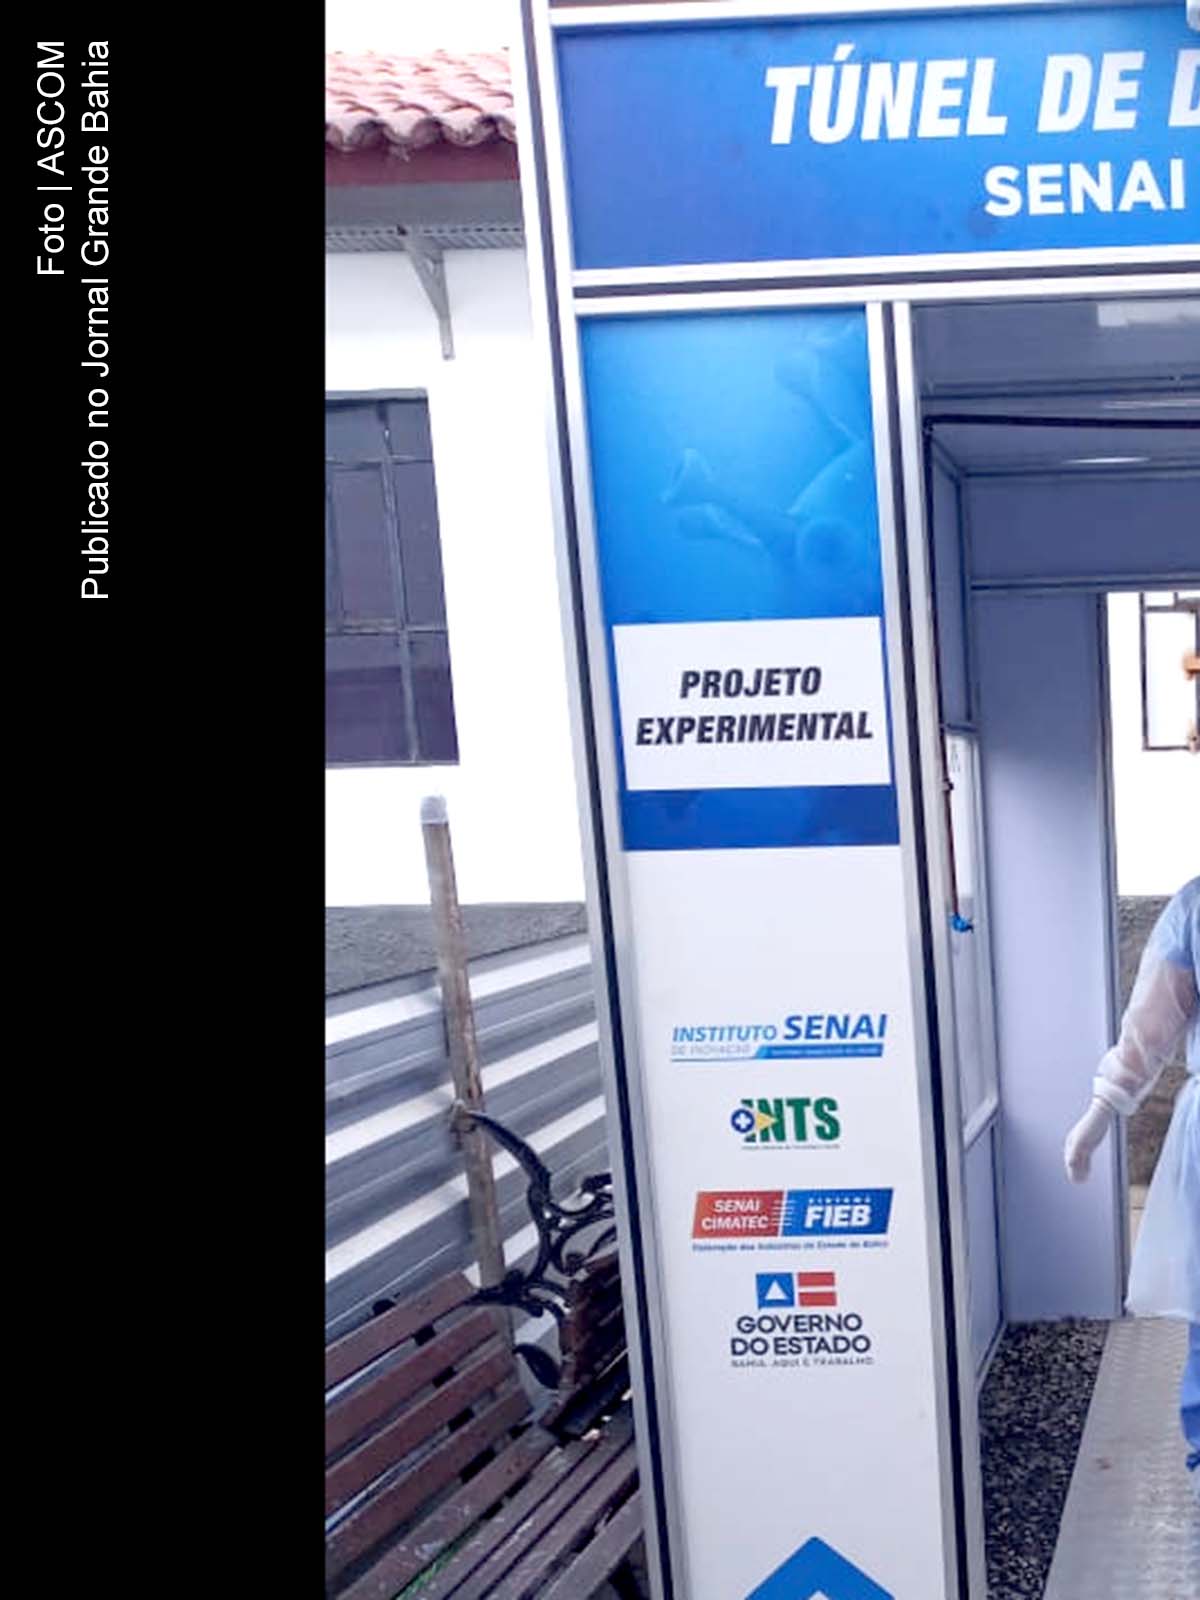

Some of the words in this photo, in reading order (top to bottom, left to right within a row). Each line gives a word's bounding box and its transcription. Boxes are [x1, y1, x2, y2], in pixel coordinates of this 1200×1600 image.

[765, 43, 1008, 145] TÚNEL
[1037, 51, 1146, 133] DE
[984, 158, 1186, 217] SENAI
[680, 666, 822, 699] PROJETO
[635, 711, 873, 746] EXPERIMENTAL
[672, 1025, 778, 1043] INSTITUTO
[783, 1013, 888, 1040] SENAI
[714, 1197, 761, 1213] SENAI
[804, 1203, 872, 1229] FIEB
[701, 1215, 769, 1231] CIMATEC
[736, 1313, 863, 1334] GOVERNO
[730, 1337, 769, 1356] DO
[773, 1335, 871, 1355] ESTADO
